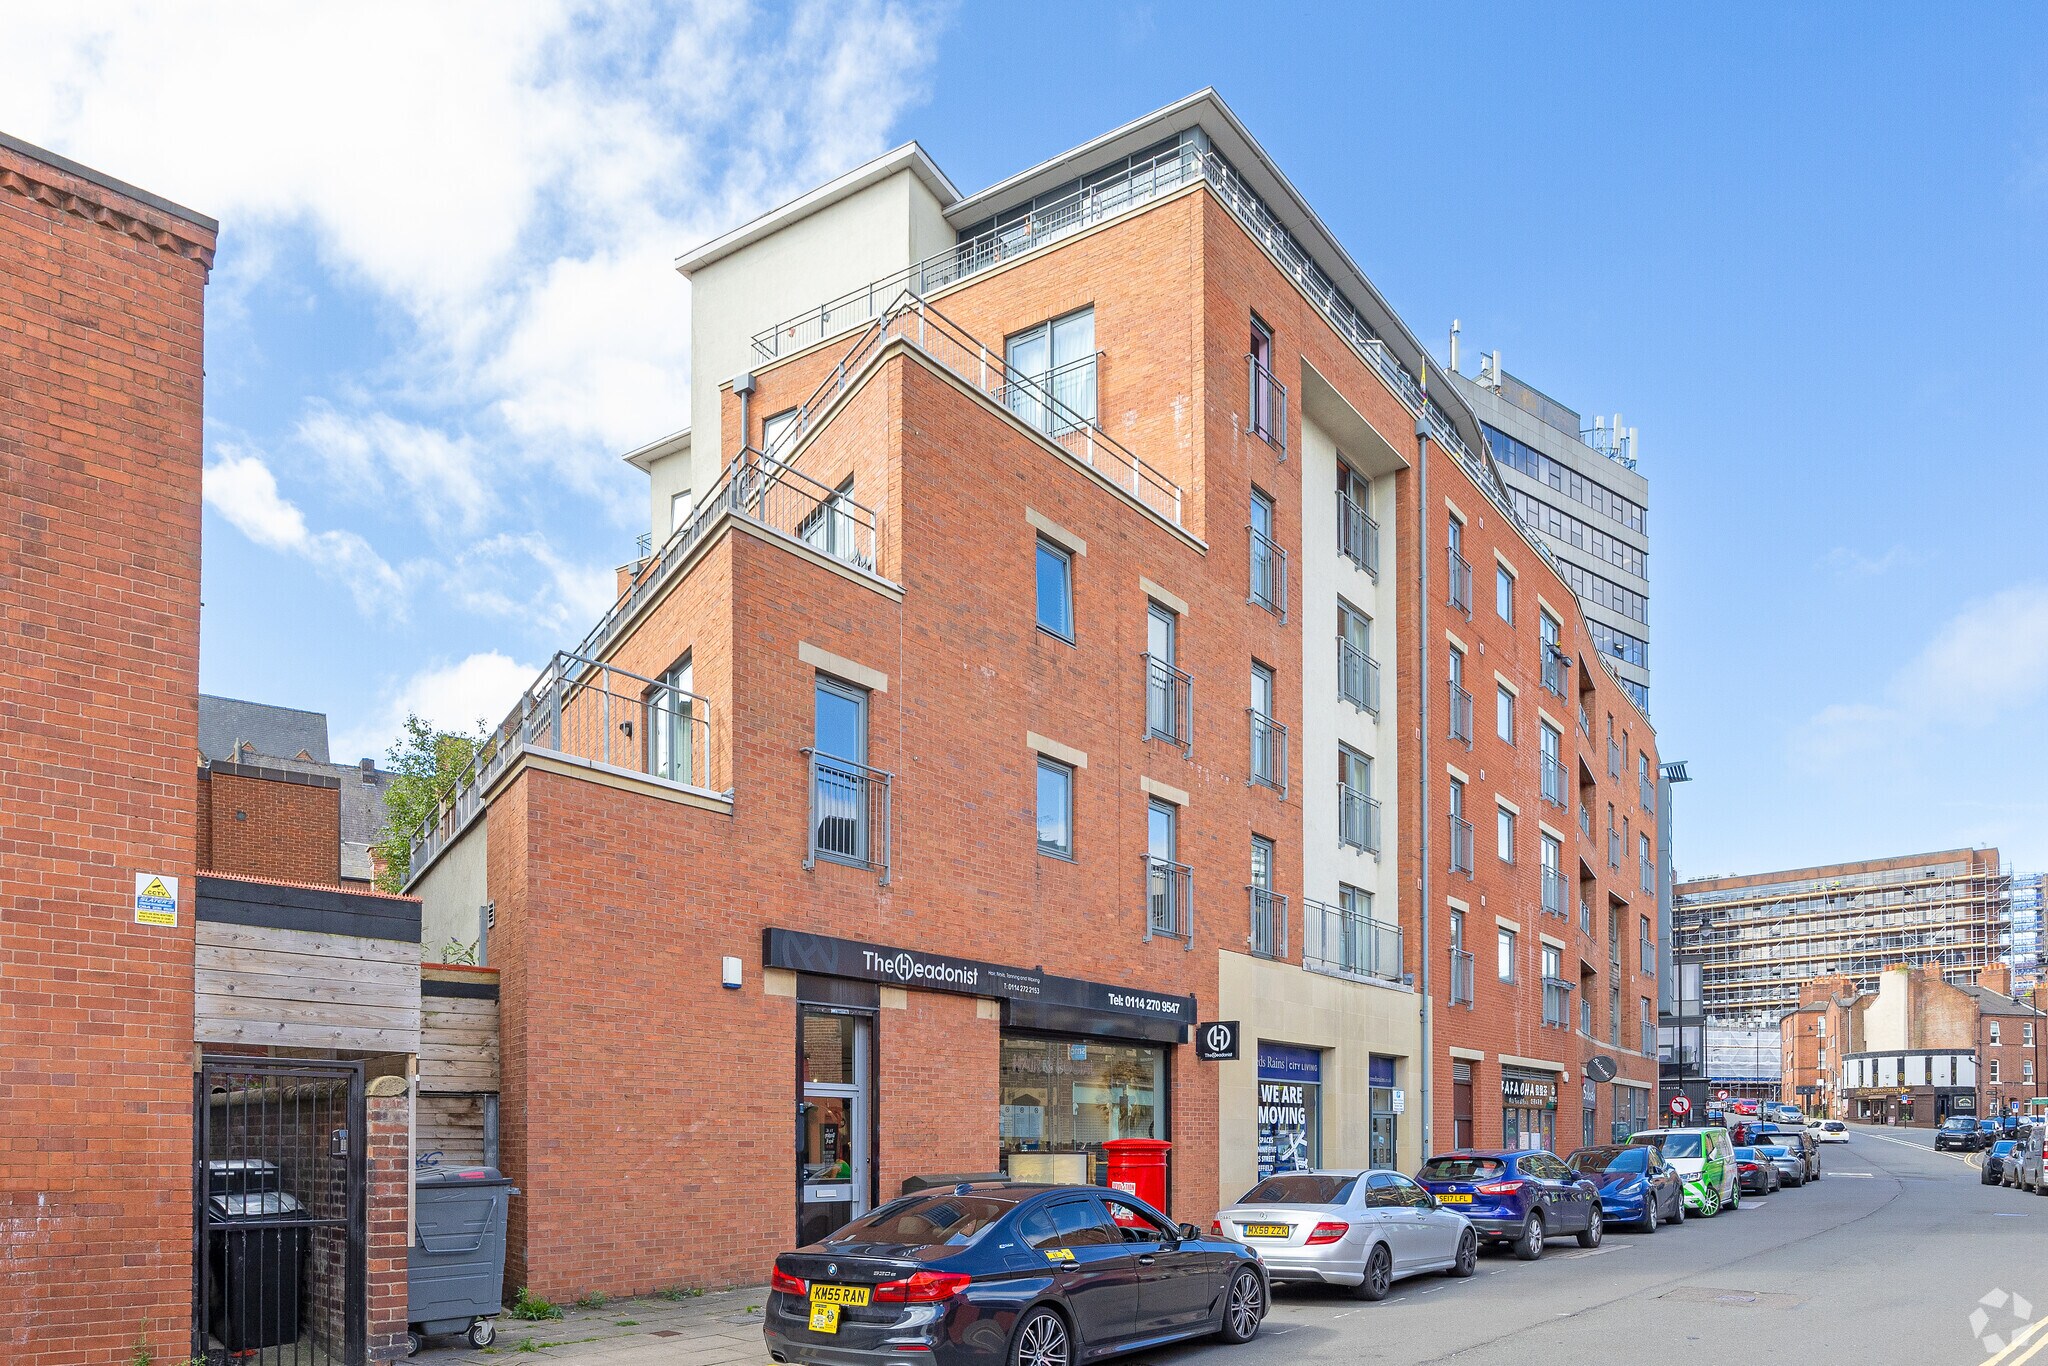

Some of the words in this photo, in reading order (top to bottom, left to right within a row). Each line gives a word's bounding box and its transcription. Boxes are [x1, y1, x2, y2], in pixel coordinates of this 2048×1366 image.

[1108, 993, 1123, 1006] Tel:
[1125, 995, 1145, 1009] 0114
[1146, 998, 1161, 1012] 270
[1162, 1001, 1180, 1014] 9547
[1257, 1055, 1266, 1068] ds
[1267, 1056, 1285, 1070] Rains
[1260, 1084, 1280, 1103] WE
[1281, 1086, 1303, 1104] ARE
[1520, 1082, 1535, 1096] CHA
[1258, 1105, 1306, 1125] MOVING
[1258, 1136, 1274, 1144] SPACES
[1262, 1155, 1276, 1163] STREET
[1271, 1225, 1288, 1235] ZZK
[815, 1287, 841, 1301] KM55
[843, 1289, 865, 1303] RAN
